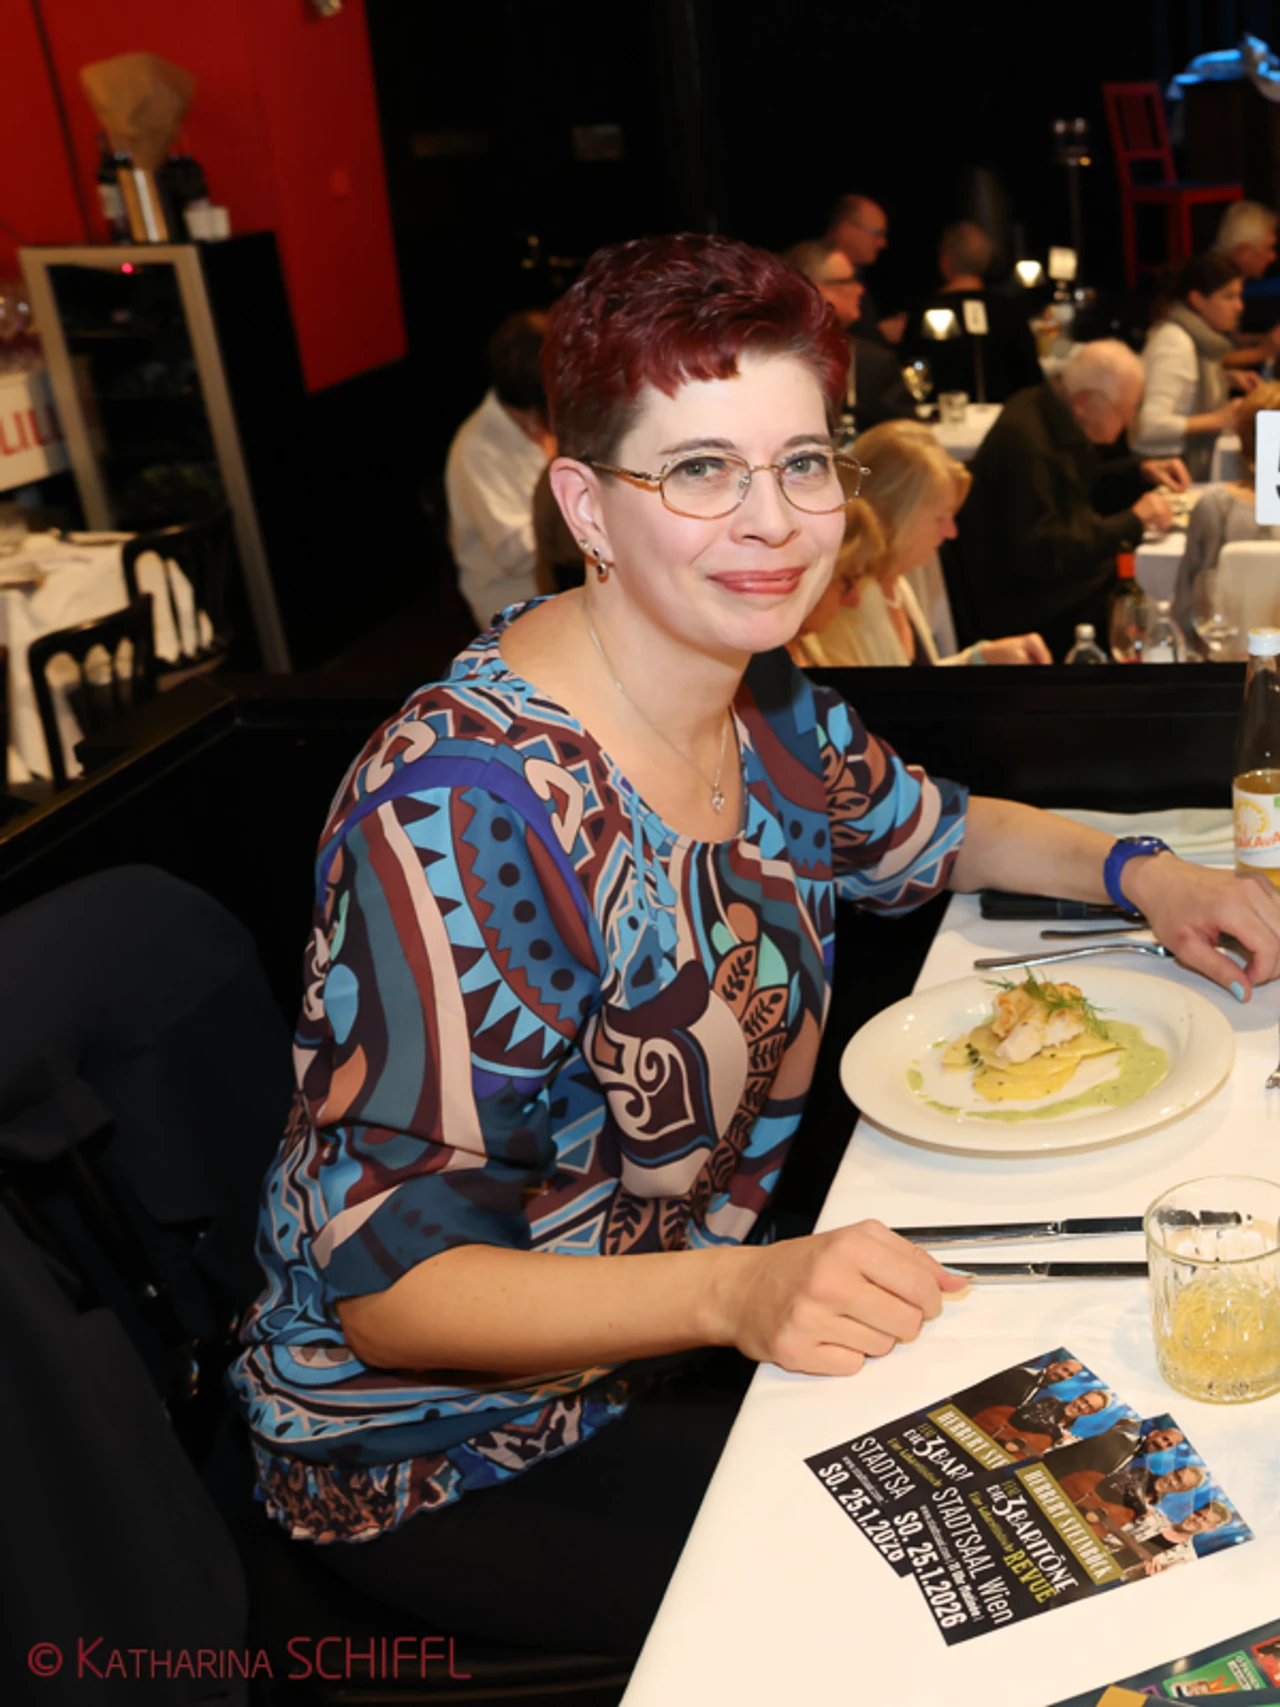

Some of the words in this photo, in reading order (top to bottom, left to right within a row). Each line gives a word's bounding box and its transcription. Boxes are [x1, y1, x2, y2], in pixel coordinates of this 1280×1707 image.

[818, 1462, 849, 1492] SO.
[893, 1510, 925, 1543] SO.
[932, 1486, 996, 1580] STADTSAAL
[977, 1576, 1014, 1625] Wien
[1024, 1469, 1067, 1522] HERBERT
[1058, 1514, 1113, 1580] STEINBÖCK
[907, 1542, 968, 1629] 25.1.2026
[1003, 1549, 1059, 1604] REVUE
